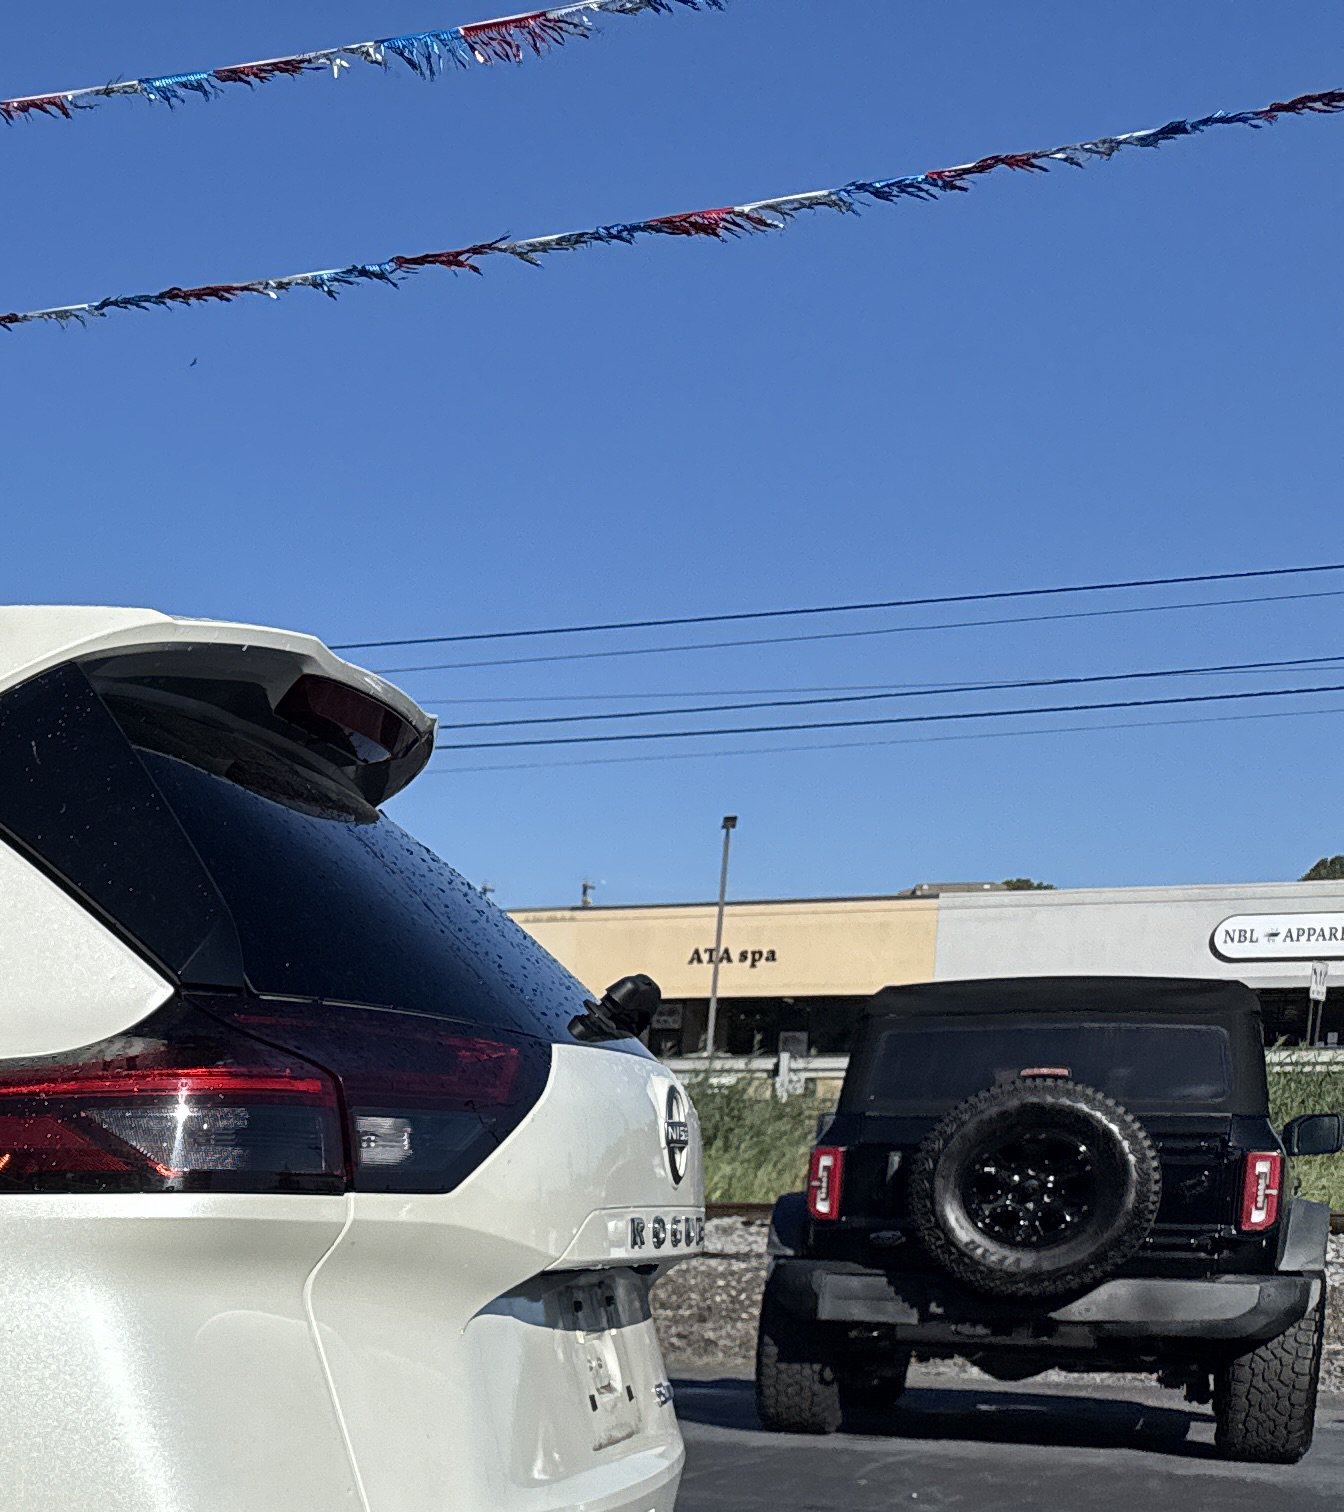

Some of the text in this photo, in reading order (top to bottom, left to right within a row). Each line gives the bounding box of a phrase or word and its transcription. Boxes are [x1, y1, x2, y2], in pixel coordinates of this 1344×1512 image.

[1223, 928, 1259, 944] NBL
[688, 946, 777, 969] ATA spa
